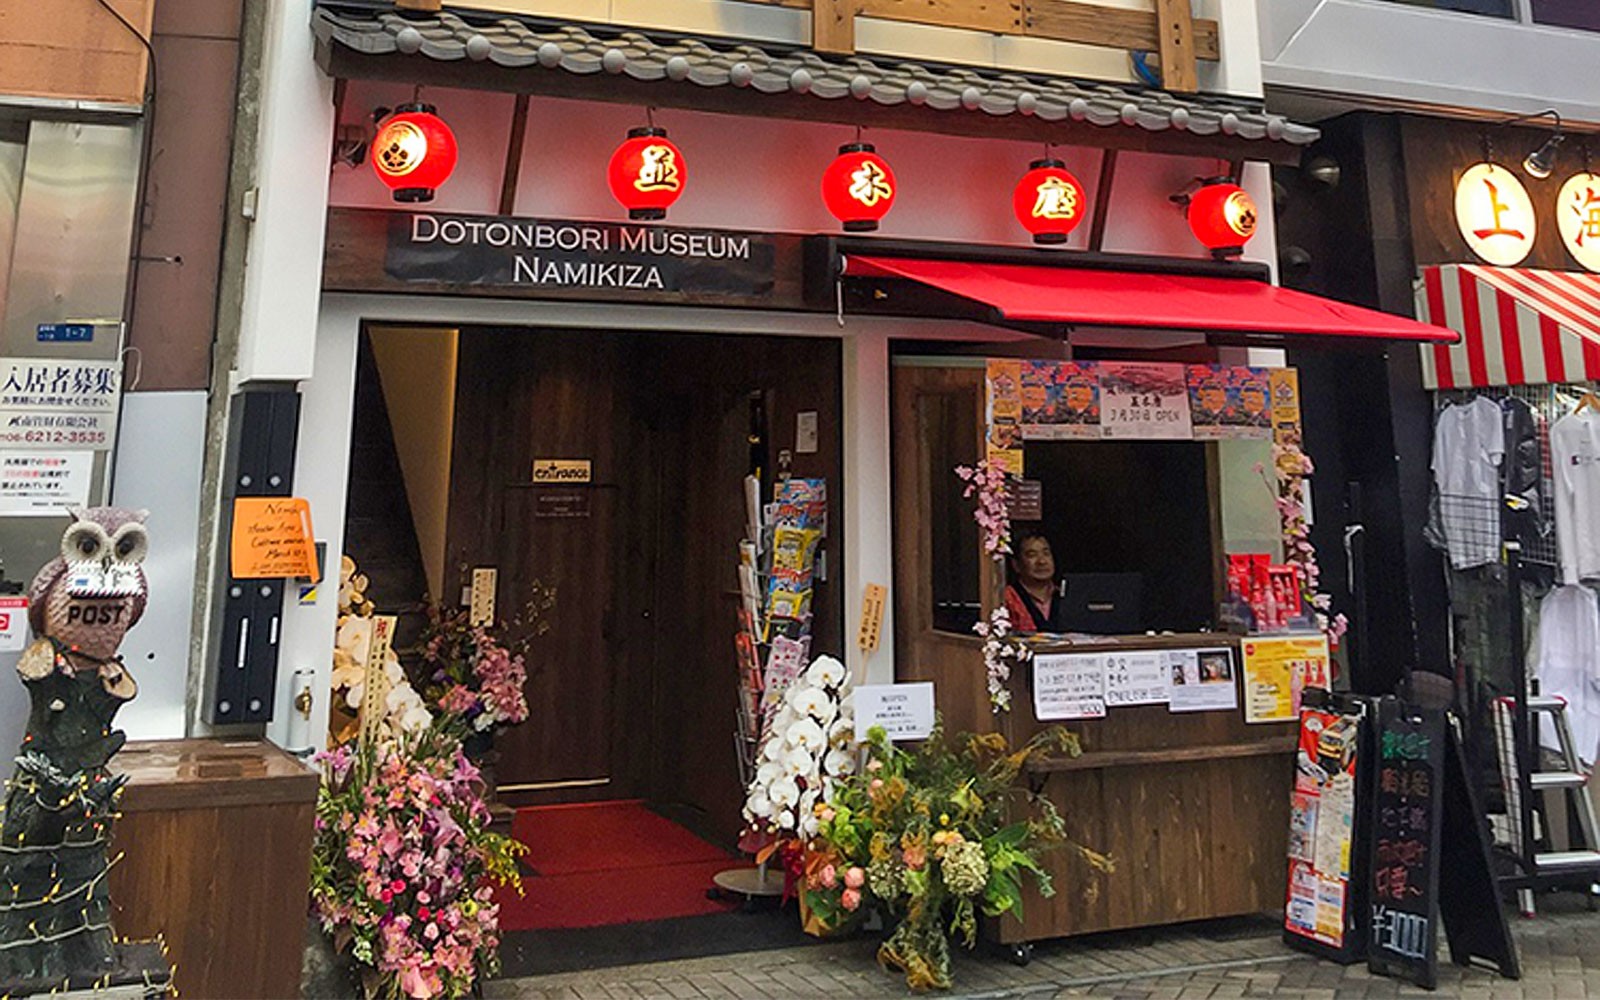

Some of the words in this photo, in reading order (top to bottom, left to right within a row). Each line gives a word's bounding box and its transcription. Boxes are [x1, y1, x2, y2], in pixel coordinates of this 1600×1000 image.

[850, 161, 893, 206] 木
[1032, 176, 1077, 218] 座
[1472, 178, 1526, 241] 上
[411, 215, 608, 251] DOTONBORI
[619, 227, 750, 259] MUSEUM
[512, 256, 665, 288] NAMIKIZA
[2, 366, 115, 394] 入居者募集
[535, 463, 590, 480] entrance
[67, 605, 125, 625] POST
